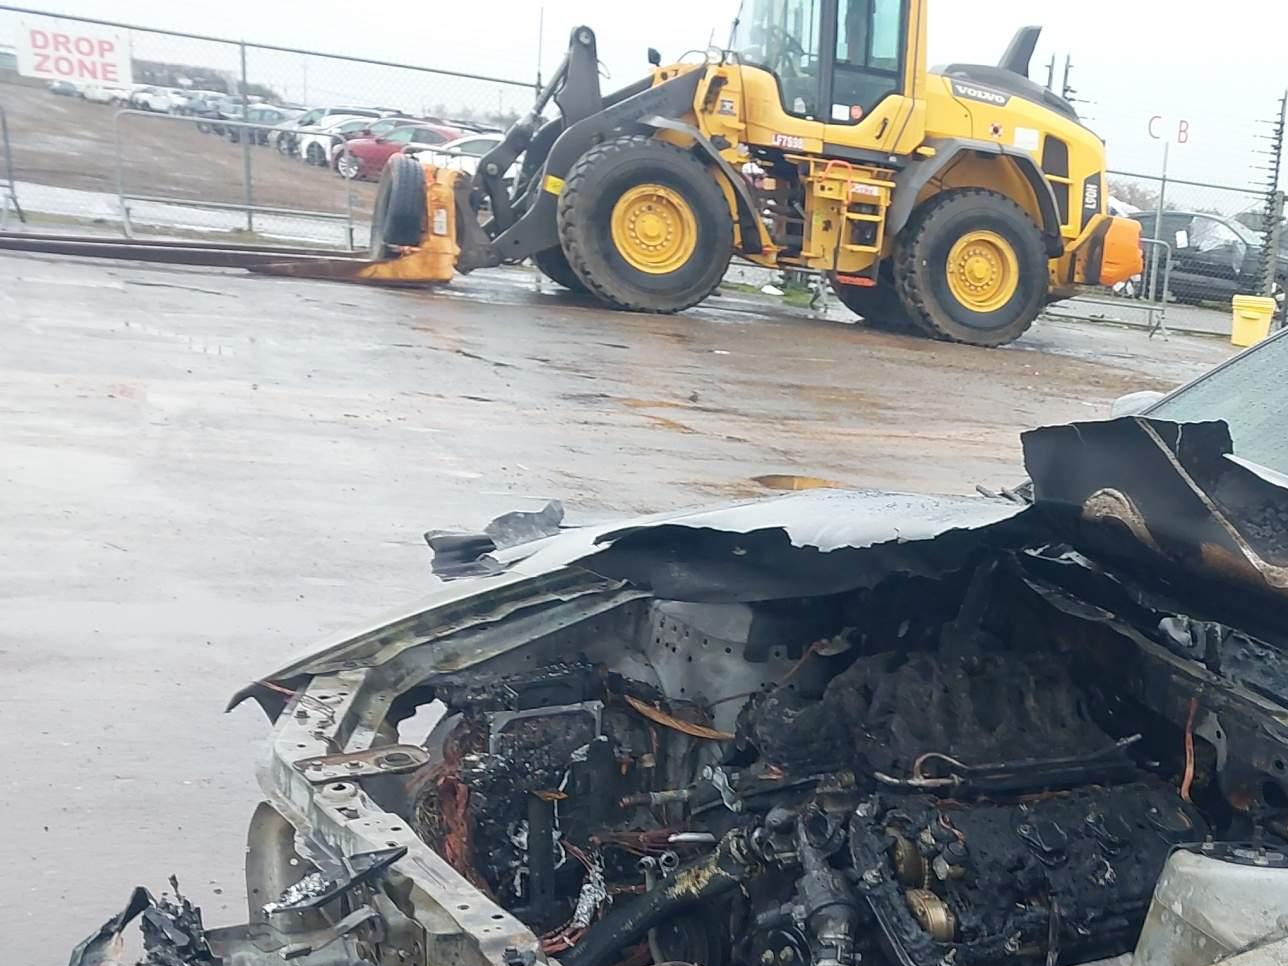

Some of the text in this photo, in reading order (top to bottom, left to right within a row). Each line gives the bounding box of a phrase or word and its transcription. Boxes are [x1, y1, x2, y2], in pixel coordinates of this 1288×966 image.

[30, 29, 115, 59] DROP
[33, 52, 120, 82] ZONE
[954, 84, 1006, 104] VOLVO
[1148, 115, 1162, 139] C
[1177, 119, 1189, 144] B
